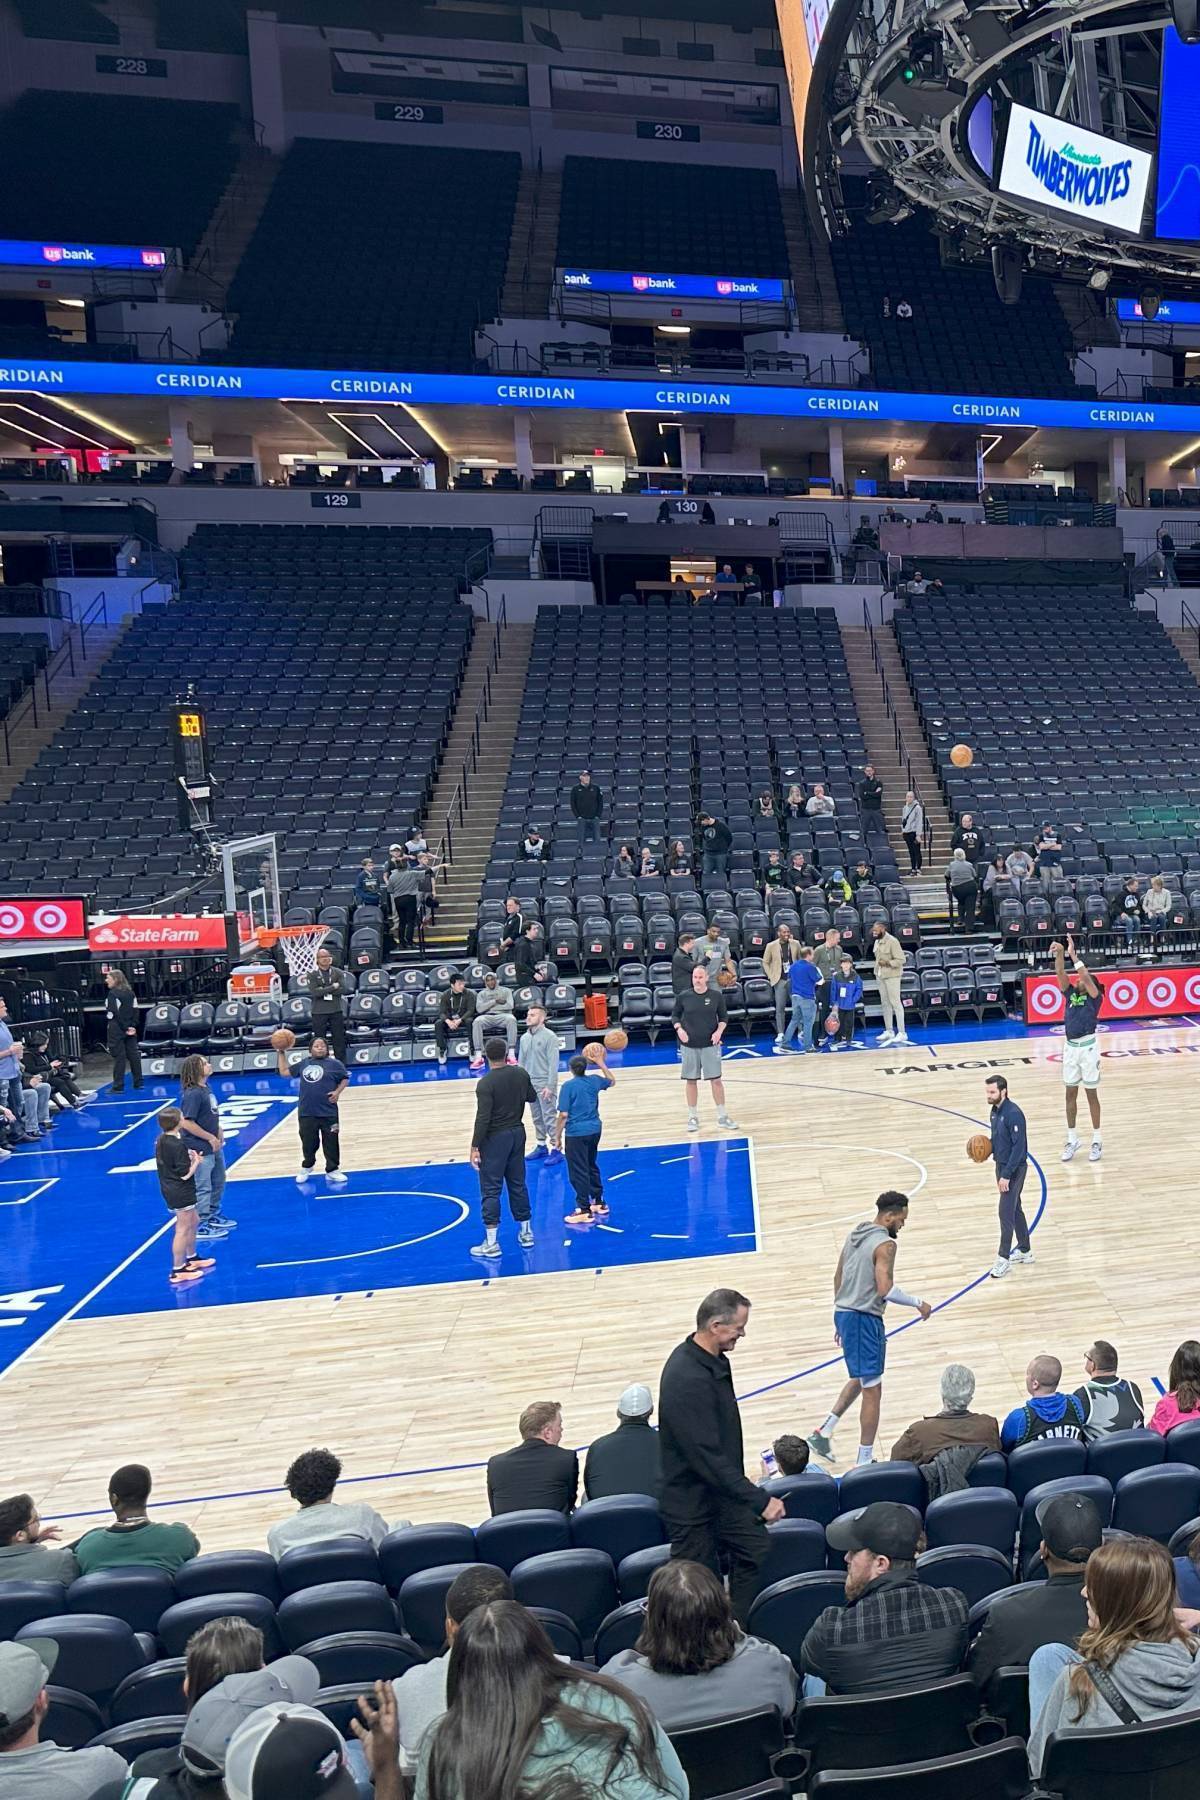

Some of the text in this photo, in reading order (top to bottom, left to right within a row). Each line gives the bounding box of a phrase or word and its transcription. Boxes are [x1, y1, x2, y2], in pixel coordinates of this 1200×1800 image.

[116, 60, 147, 74] 228
[394, 106, 424, 119] 229
[655, 125, 681, 139] 230
[1026, 119, 1132, 206] TIMBERWOLVES
[157, 374, 241, 389] CERIDIAN
[331, 380, 412, 394] CERIDIAN
[497, 386, 575, 399] CERIDIAN
[656, 391, 730, 405] CERIDIAN
[808, 398, 879, 411] CERIDIAN
[952, 404, 1020, 417] CERIDIAN
[1090, 410, 1154, 423] CERIDIAN
[324, 495, 349, 506] 129
[676, 502, 698, 512] 130
[120, 928, 200, 942] State Farm
[437, 968, 449, 979] G
[472, 966, 483, 977] G
[505, 964, 516, 976] G
[244, 976, 255, 986] G
[368, 972, 380, 983] G
[404, 971, 416, 983] G
[520, 988, 532, 1000] G
[555, 986, 567, 998] G
[360, 997, 372, 1008] G
[392, 995, 403, 1006] G
[425, 993, 436, 1005] G
[190, 1005, 202, 1017] G
[226, 1004, 239, 1015] G
[258, 1002, 270, 1013] G
[291, 1000, 303, 1012] G
[155, 1007, 167, 1019] G
[356, 1049, 369, 1061] G
[389, 1047, 402, 1059] G
[423, 1044, 436, 1057] G
[456, 1043, 469, 1056] G
[150, 1060, 165, 1073] G
[219, 1056, 233, 1070] G
[254, 1054, 268, 1068] G
[877, 1057, 1035, 1077] TARGET
